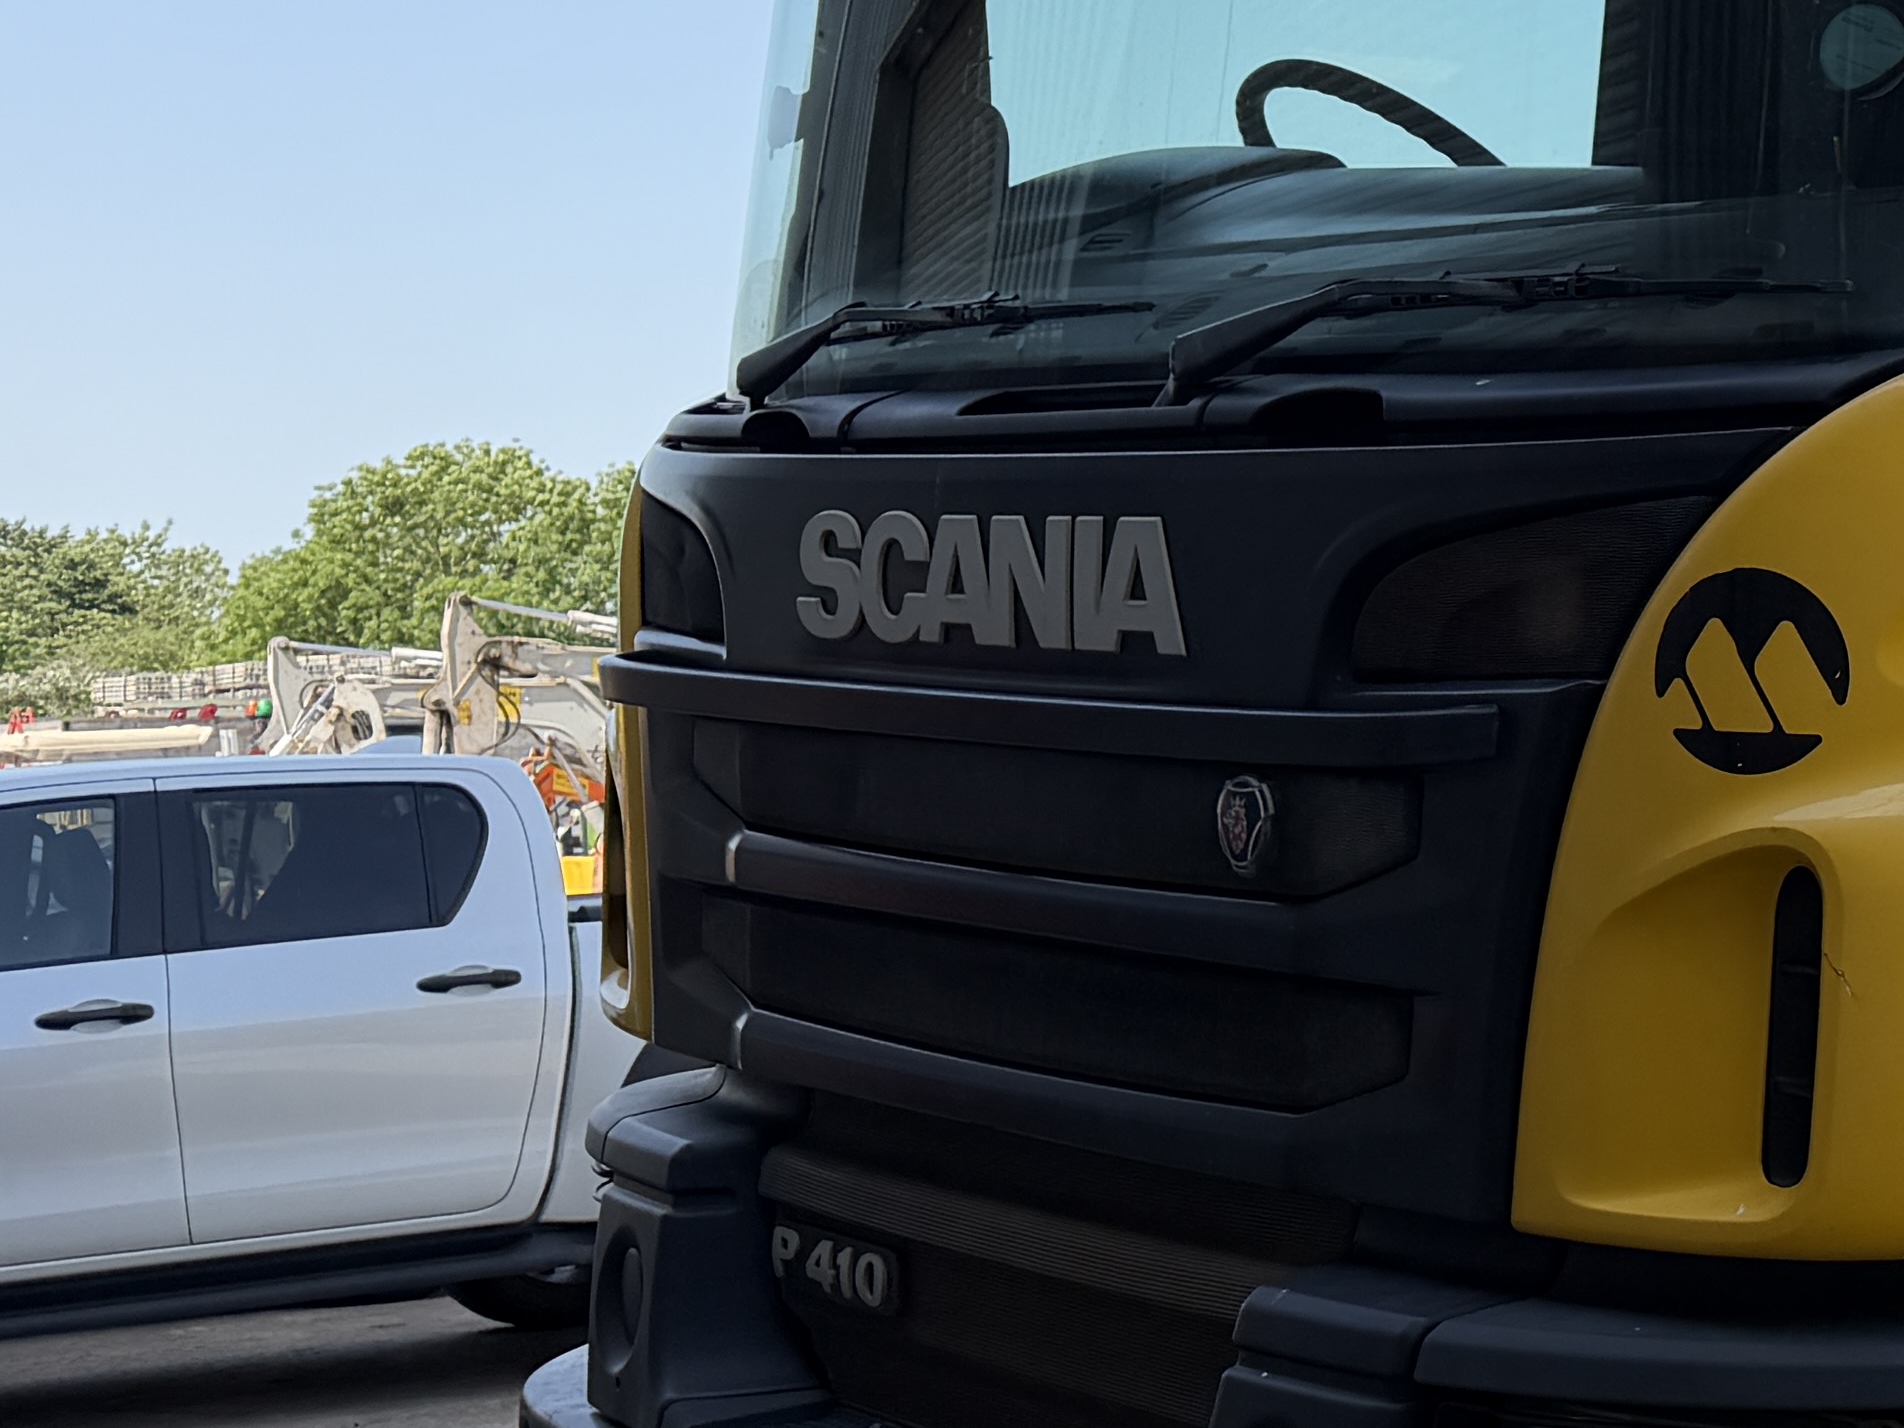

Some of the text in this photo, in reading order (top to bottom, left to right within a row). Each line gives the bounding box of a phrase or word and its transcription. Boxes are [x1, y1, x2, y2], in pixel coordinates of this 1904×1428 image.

[795, 509, 1188, 658] SCANIA
[772, 1225, 888, 1308] P 410
